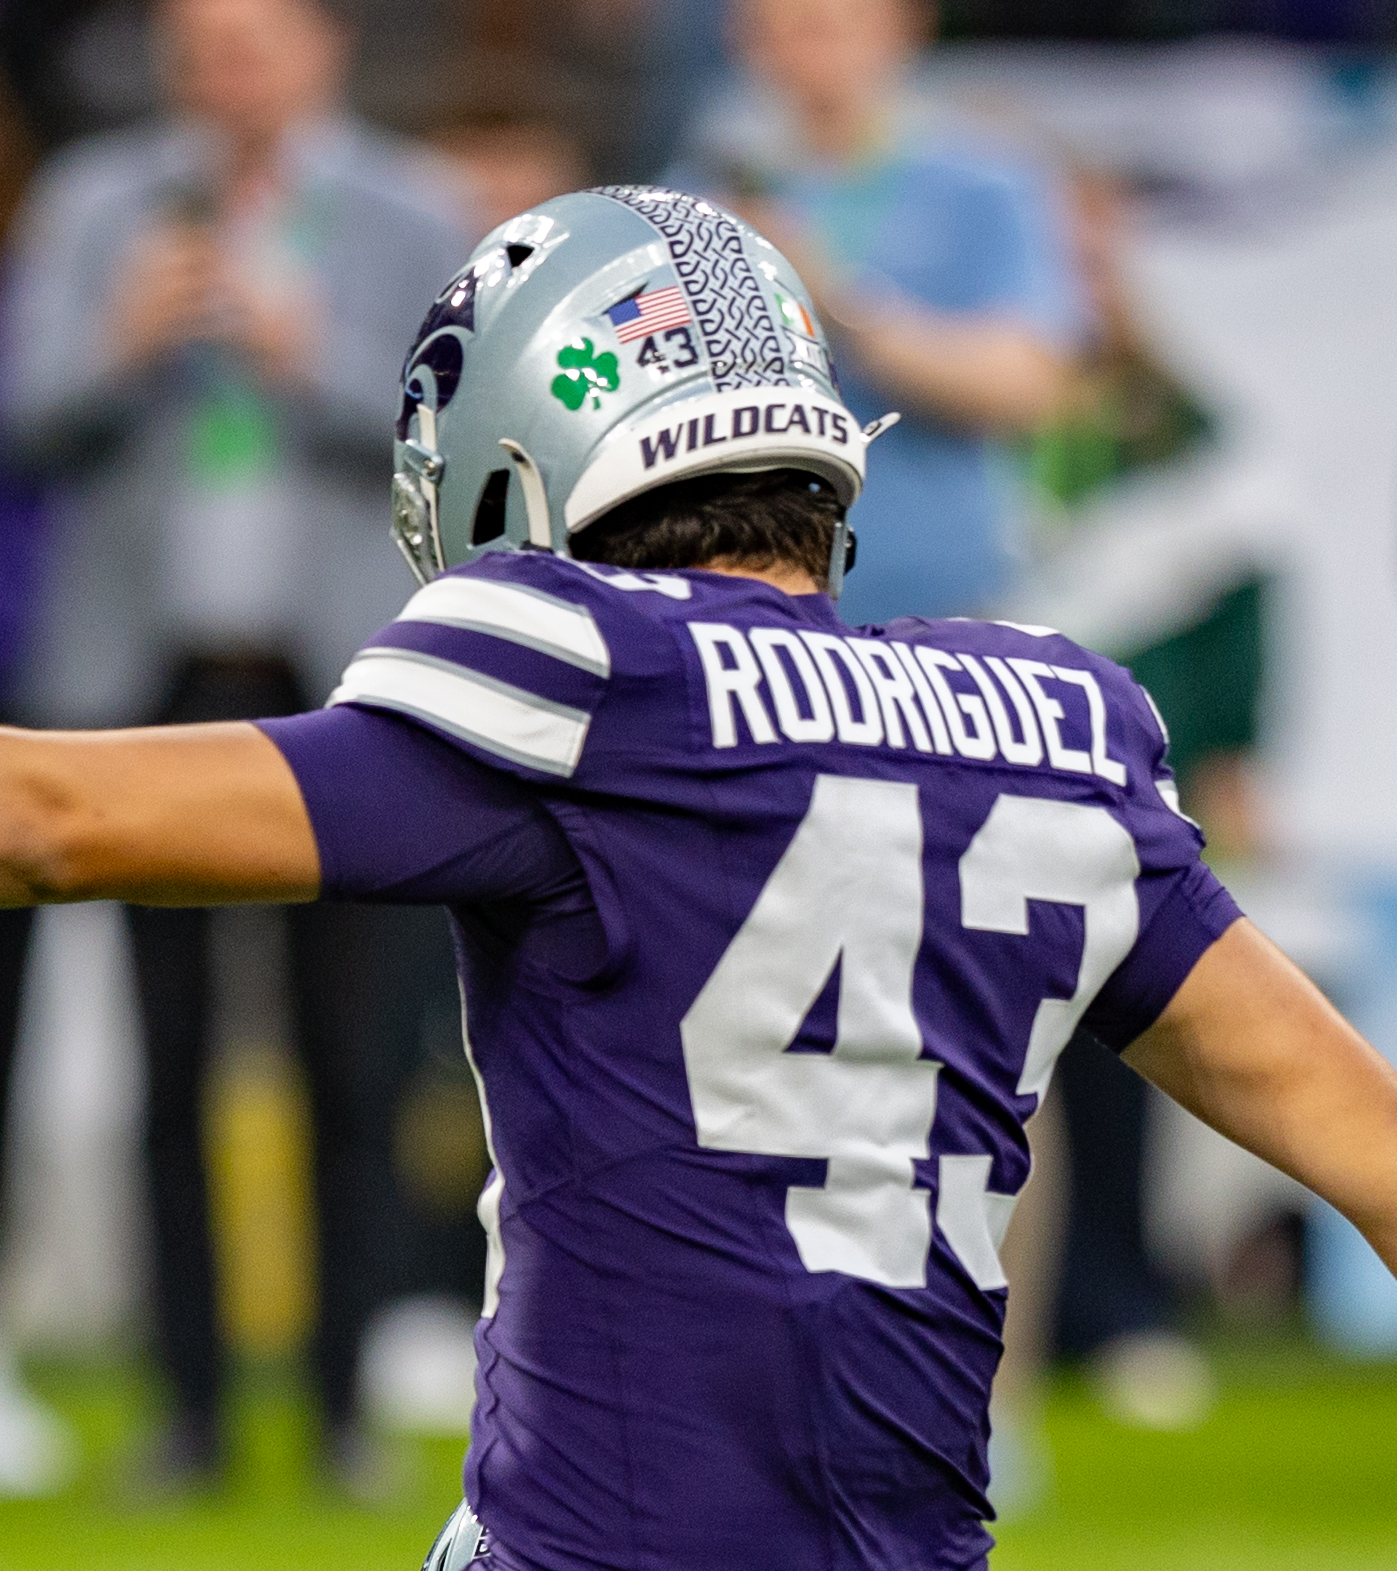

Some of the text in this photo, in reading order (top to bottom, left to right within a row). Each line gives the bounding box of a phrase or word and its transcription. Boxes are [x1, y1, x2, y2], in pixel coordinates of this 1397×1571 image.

[636, 327, 699, 375] 43
[640, 403, 848, 469] WILDCATS
[687, 622, 1127, 787] RODRIGUEZ
[680, 774, 1141, 1291] 43
